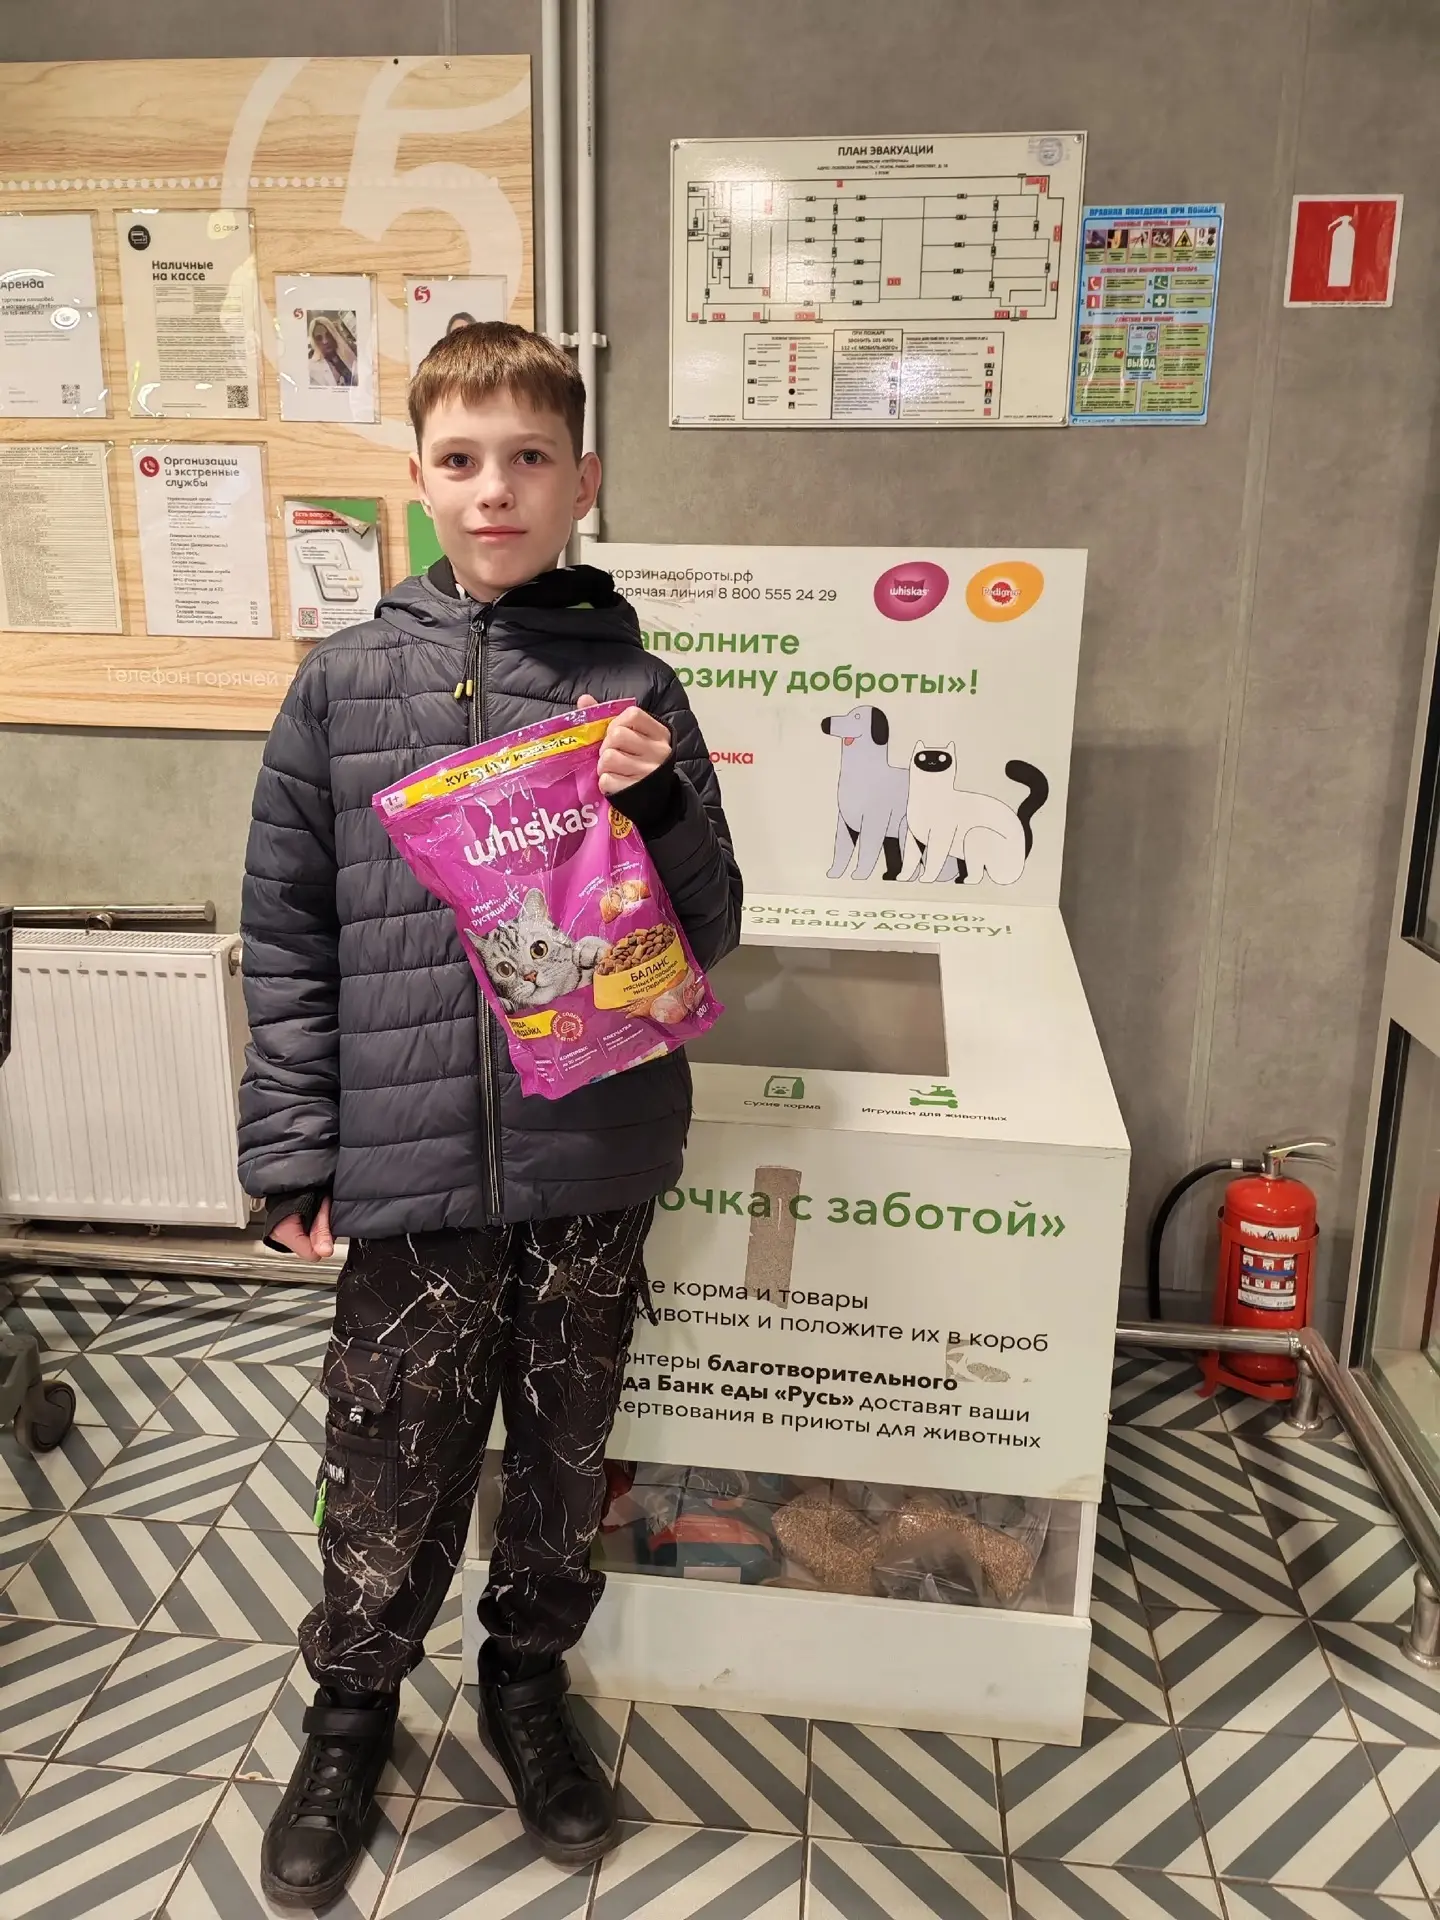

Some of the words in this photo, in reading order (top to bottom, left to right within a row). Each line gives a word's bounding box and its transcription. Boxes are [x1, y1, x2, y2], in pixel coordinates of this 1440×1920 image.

[838, 146, 867, 156] ПЛАН
[870, 145, 934, 156] ЭВАКУАЦИИ
[152, 260, 214, 270] Наличные
[152, 272, 167, 280] на
[171, 272, 205, 280] кассе
[1127, 358, 1156, 368] ВЫХОД
[164, 457, 238, 467] Организации
[175, 469, 240, 478] экстренные
[166, 478, 208, 488] службы
[608, 568, 753, 584] корзинадоброты.рф
[615, 587, 666, 598] орячая
[670, 588, 714, 599] линия
[718, 588, 728, 599] 8
[732, 588, 760, 600] 800
[765, 589, 791, 600] 555
[796, 590, 814, 600] 24
[818, 590, 837, 601] 29
[890, 586, 929, 596] whiskas
[640, 630, 800, 655] аполните
[102, 664, 190, 685] Телефон
[197, 670, 279, 688] горячей
[675, 666, 778, 696] рзину
[786, 664, 978, 698] доброты»!
[463, 803, 599, 867] whiskas
[471, 896, 514, 927] рустящий
[825, 908, 840, 917] с
[848, 909, 986, 923] заботой»
[750, 916, 780, 924] за
[791, 918, 867, 931] вашу
[874, 921, 1012, 936] доброту!
[630, 955, 671, 982] БАЛАНС
[743, 1100, 781, 1110] Сухие
[862, 1107, 916, 1117] Игрушки
[945, 1113, 1008, 1122] животных
[789, 1195, 813, 1220] с
[827, 1192, 1066, 1238] заботой»
[673, 1281, 748, 1300] корма
[757, 1288, 770, 1301] и
[779, 1289, 868, 1309] товары
[758, 1315, 771, 1329] и
[780, 1317, 904, 1340] положите
[911, 1327, 940, 1343] их
[949, 1331, 961, 1344] в
[969, 1333, 1048, 1353] короб
[707, 1354, 958, 1391] благотворительного
[657, 1375, 714, 1395] Банк
[721, 1384, 768, 1401] еды
[775, 1385, 855, 1408] «Русь»
[859, 1396, 962, 1417] доставят
[969, 1405, 1030, 1423] ваши
[762, 1412, 774, 1424] в
[781, 1413, 870, 1433] приюты
[876, 1423, 915, 1438] для
[923, 1426, 1042, 1448] животных
